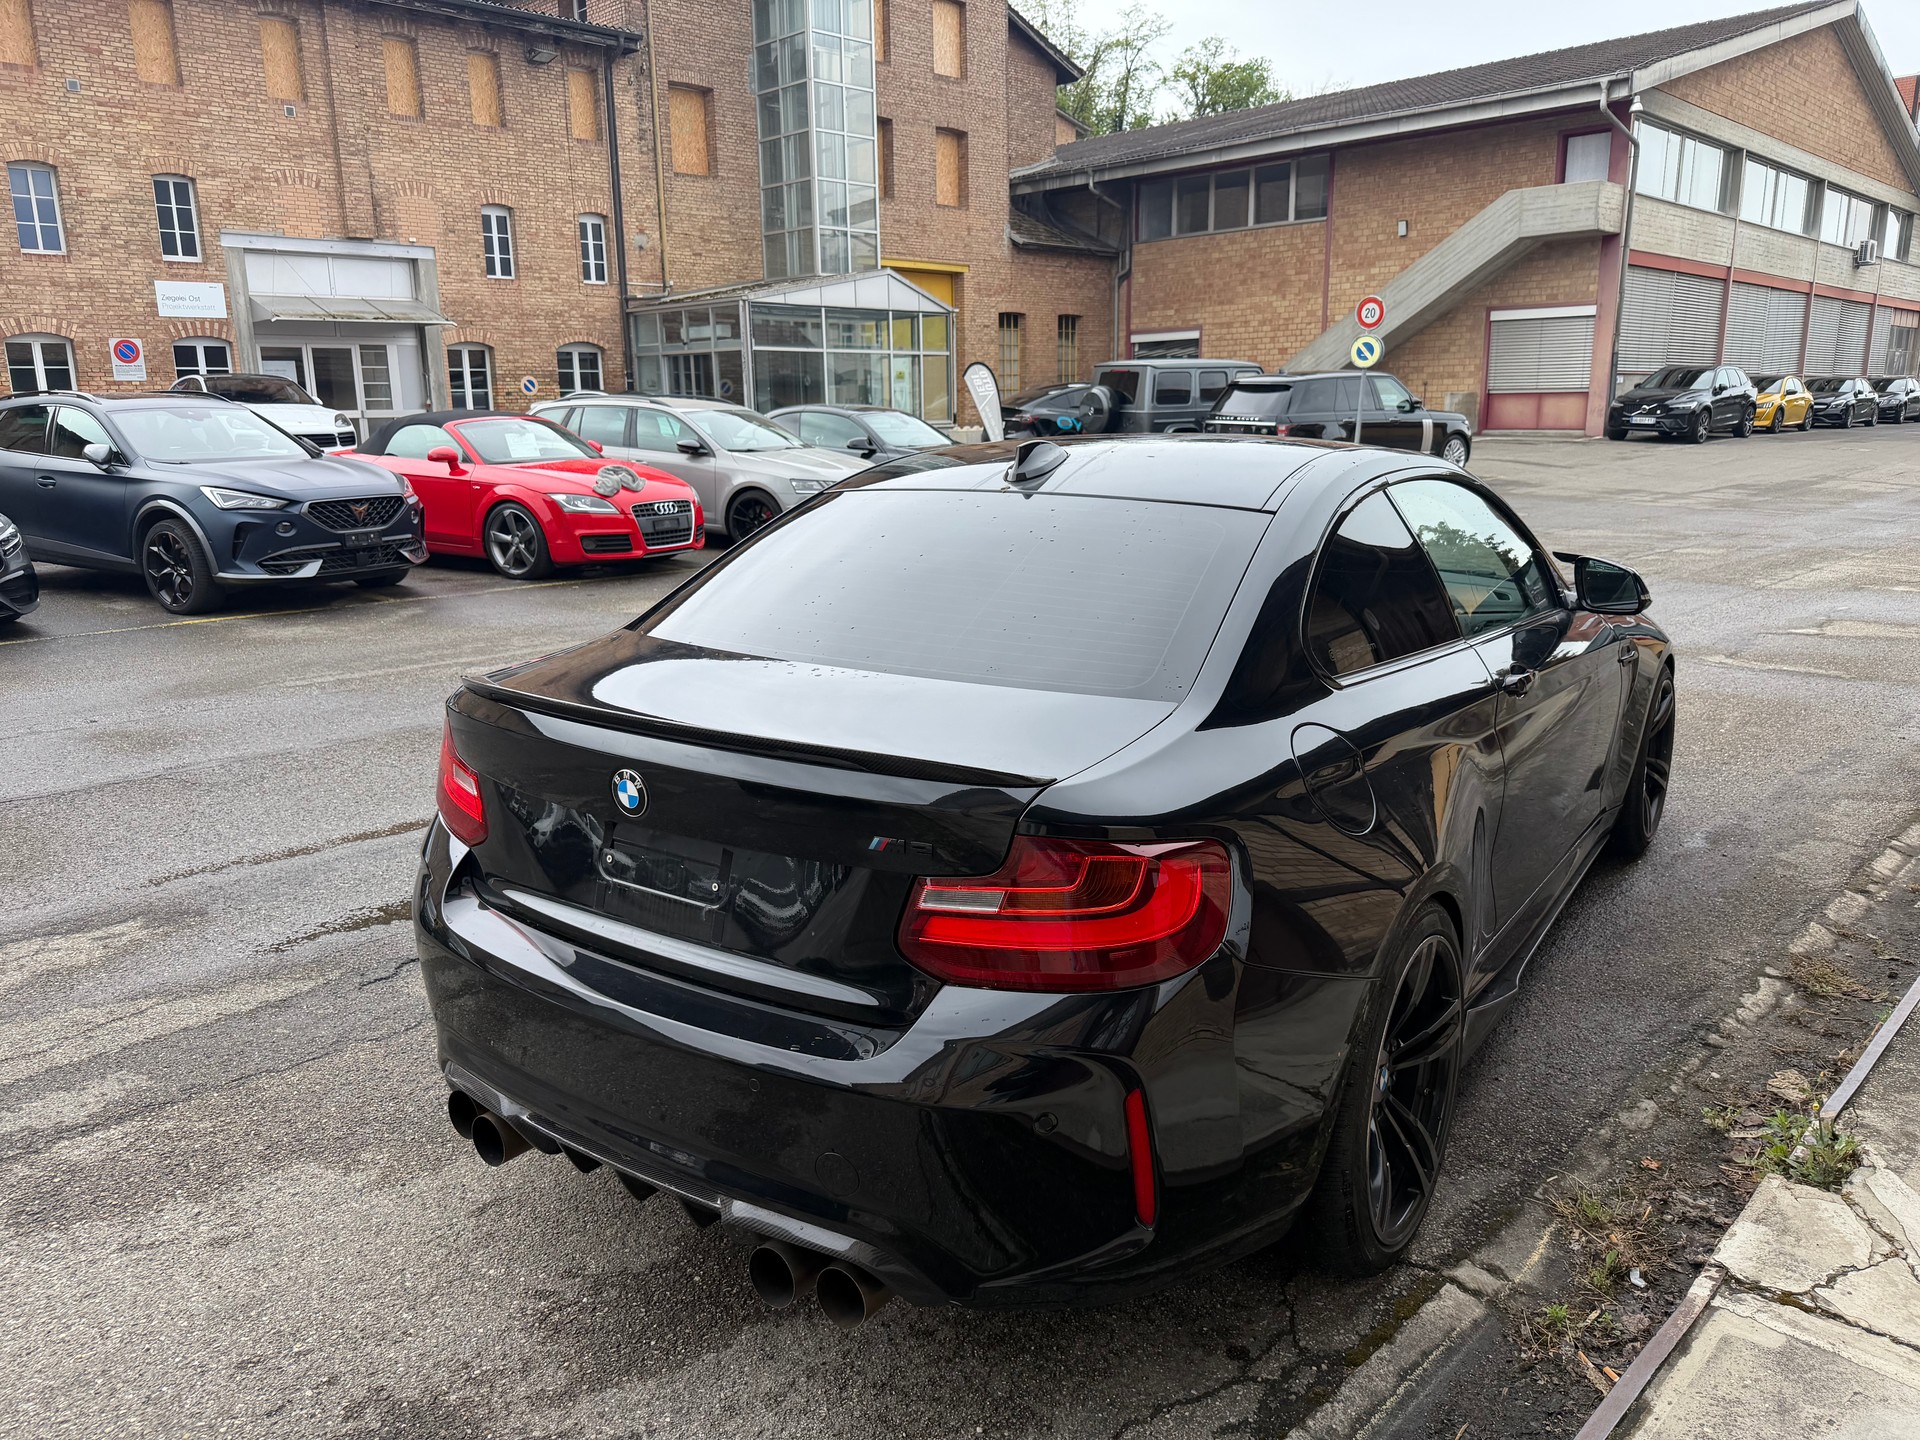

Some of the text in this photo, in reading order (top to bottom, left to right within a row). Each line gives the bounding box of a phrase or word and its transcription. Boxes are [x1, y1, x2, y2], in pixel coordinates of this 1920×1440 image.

[188, 295, 201, 303] Ost
[1365, 307, 1376, 319] 20
[614, 771, 642, 790] BMW
